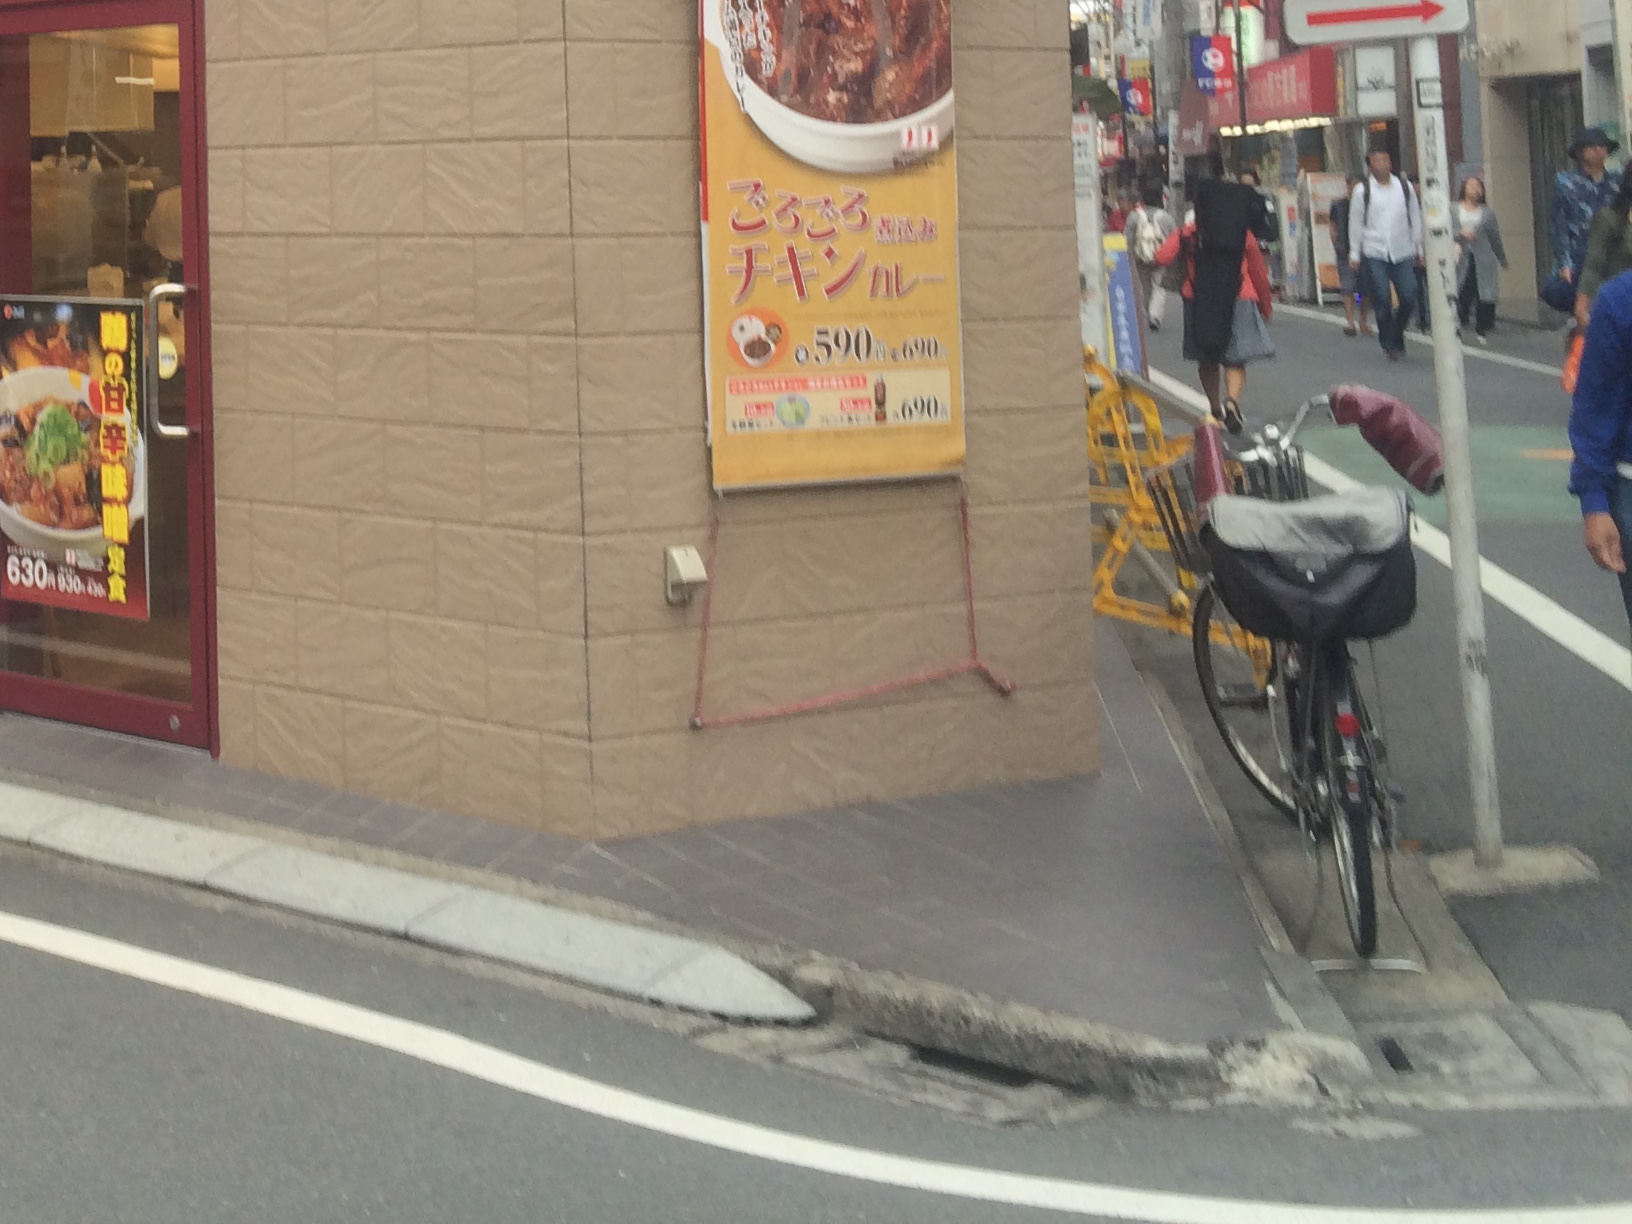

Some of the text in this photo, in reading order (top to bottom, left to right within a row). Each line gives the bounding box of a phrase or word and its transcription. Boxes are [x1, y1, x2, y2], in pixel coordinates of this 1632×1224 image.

[725, 242, 945, 306] チキンカレー
